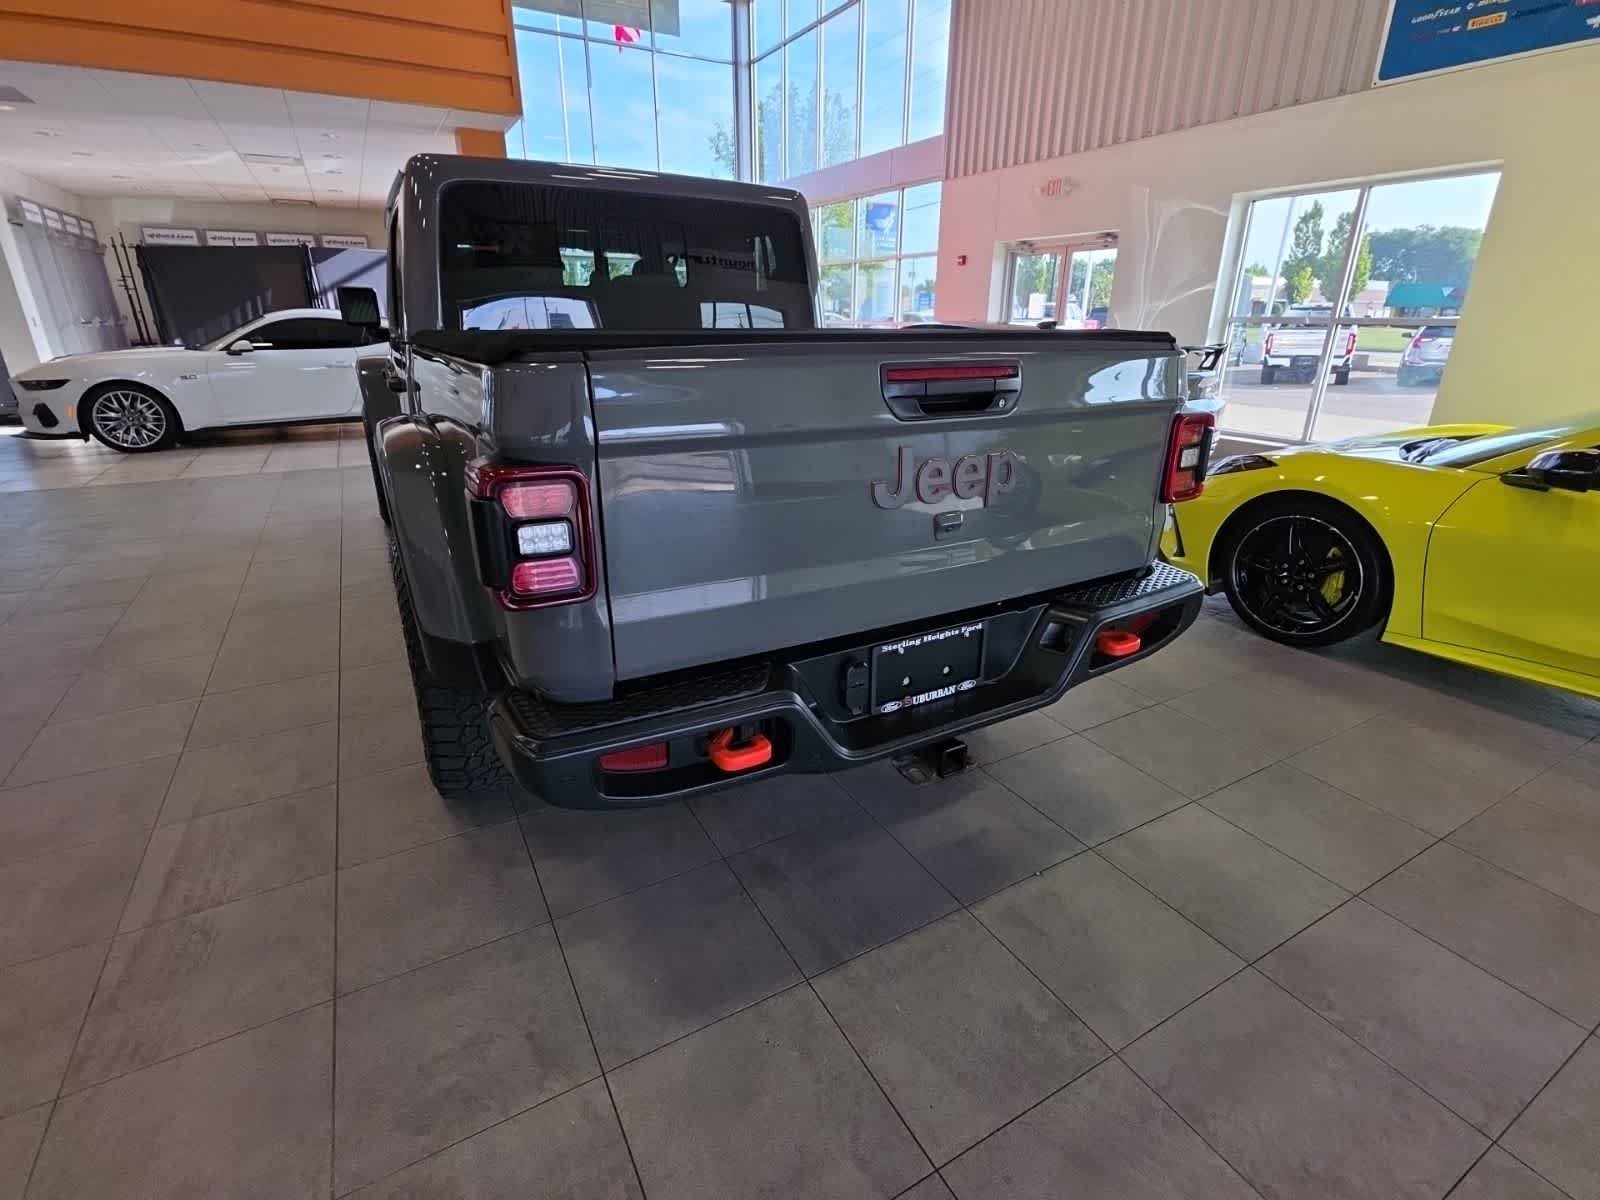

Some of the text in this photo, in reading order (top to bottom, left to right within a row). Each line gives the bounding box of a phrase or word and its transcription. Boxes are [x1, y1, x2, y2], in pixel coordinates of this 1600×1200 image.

[871, 445, 1016, 510] Jeep
[881, 623, 982, 652] Sterling Heights Ford
[903, 685, 956, 707] SUBURBAN
